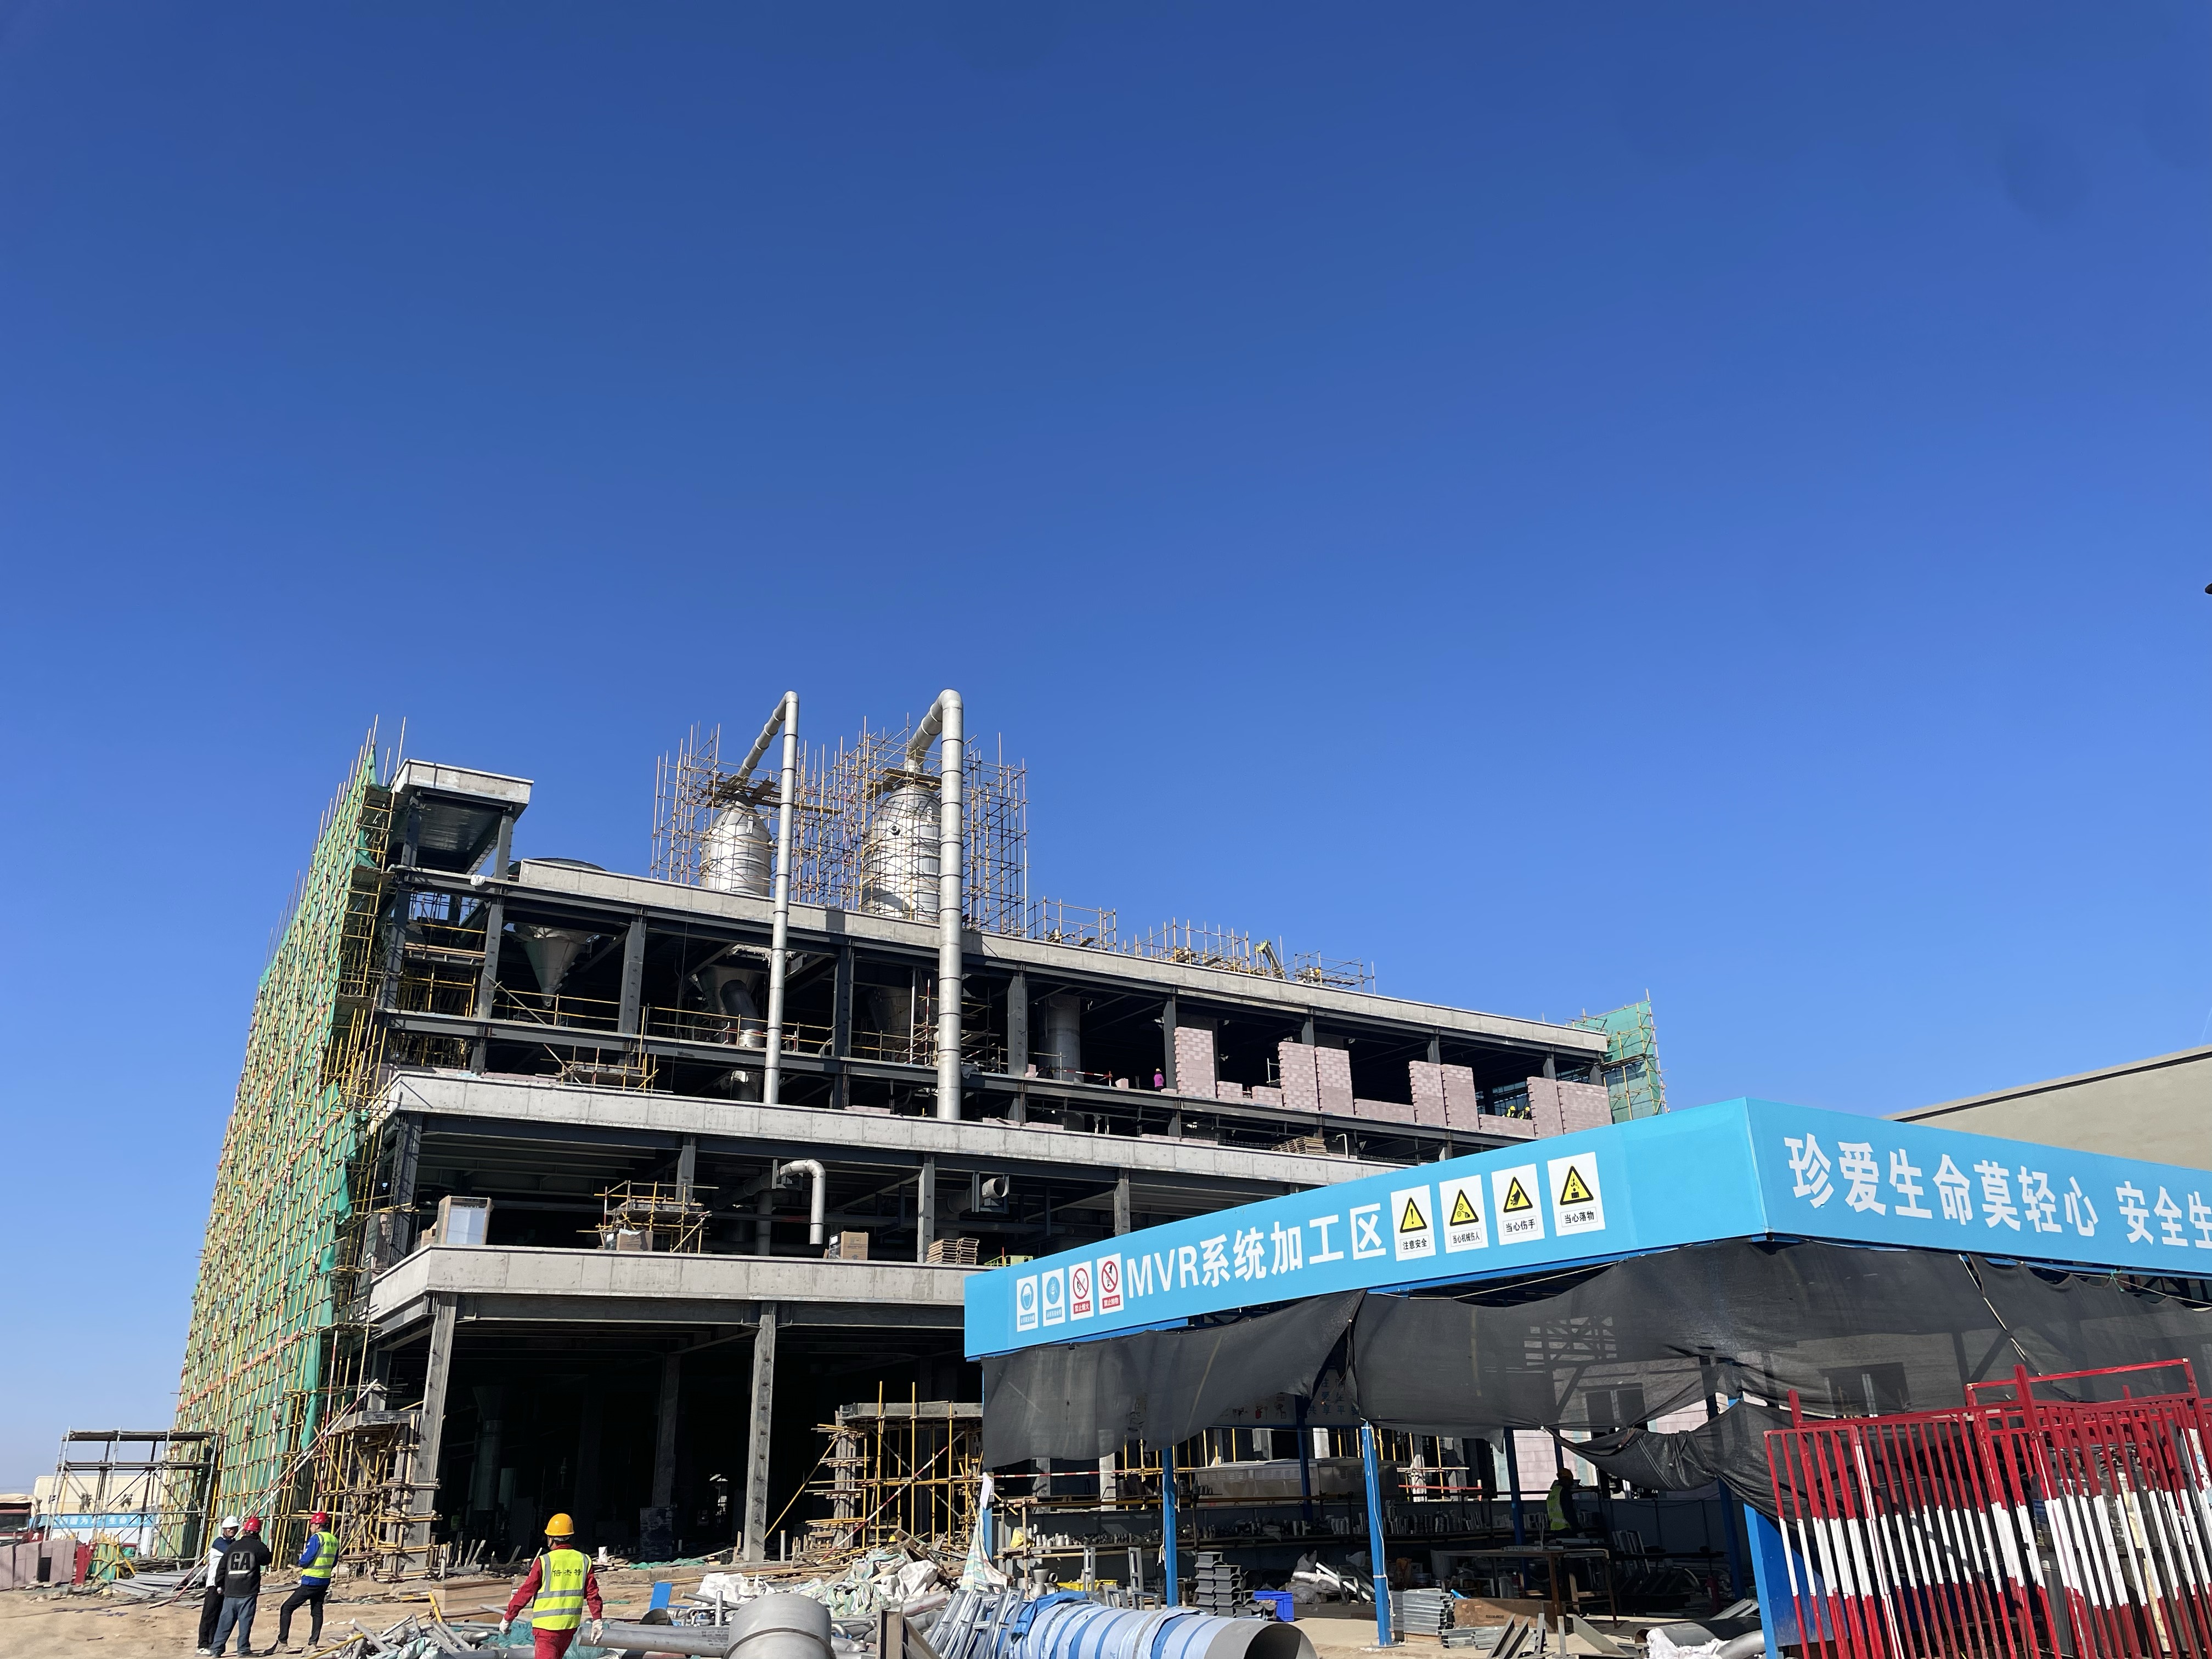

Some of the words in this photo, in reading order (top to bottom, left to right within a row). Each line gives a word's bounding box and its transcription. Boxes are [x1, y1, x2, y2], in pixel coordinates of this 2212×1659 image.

[1784, 1133, 2098, 1236] 珍爱生命莫轻心
[1565, 1211, 1594, 1224] 当心落物
[1506, 1218, 1535, 1232] 当心伤手
[1403, 1238, 1427, 1250] 注意安全
[1453, 1232, 1480, 1244] 当心机械伤人
[1127, 1203, 1386, 1299] MVR系统加工区
[552, 1568, 582, 1577] 倍杰特
